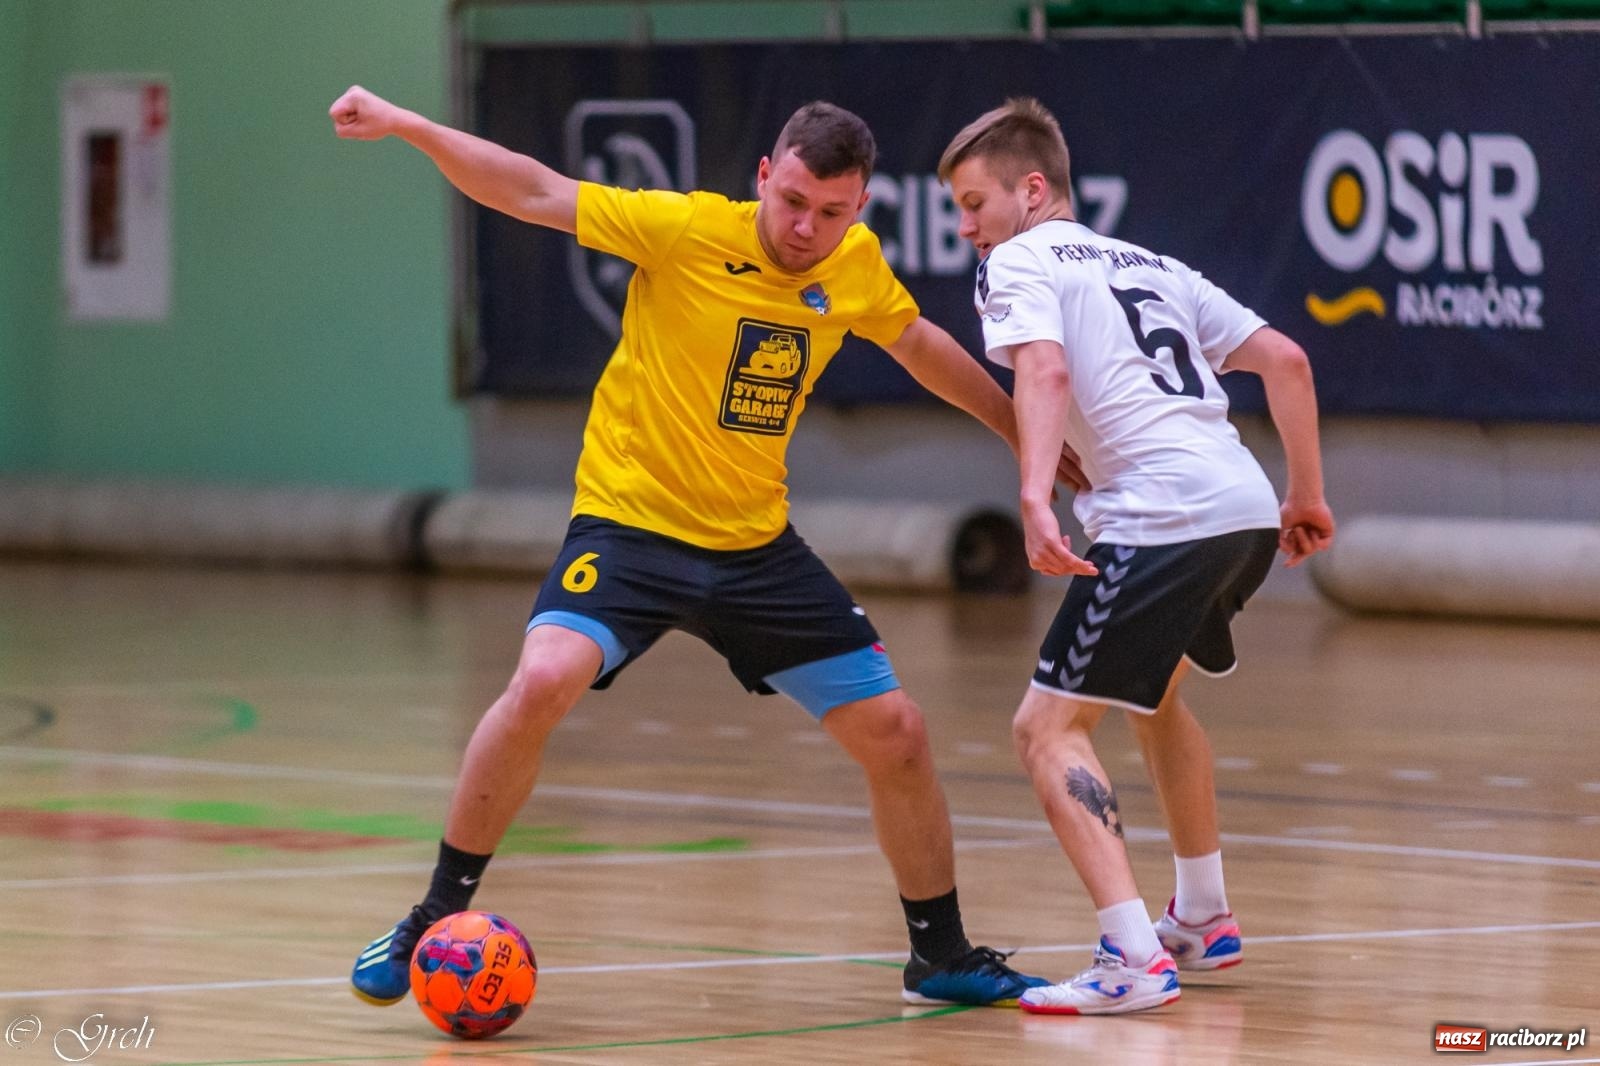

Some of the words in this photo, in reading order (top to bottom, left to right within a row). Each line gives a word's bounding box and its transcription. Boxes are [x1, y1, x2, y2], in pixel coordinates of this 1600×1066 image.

[1302, 129, 1544, 276] OSiR
[1110, 285, 1205, 400] 5
[733, 381, 793, 402] STOPIW
[562, 552, 600, 593] 6
[478, 941, 513, 1006] SELECT
